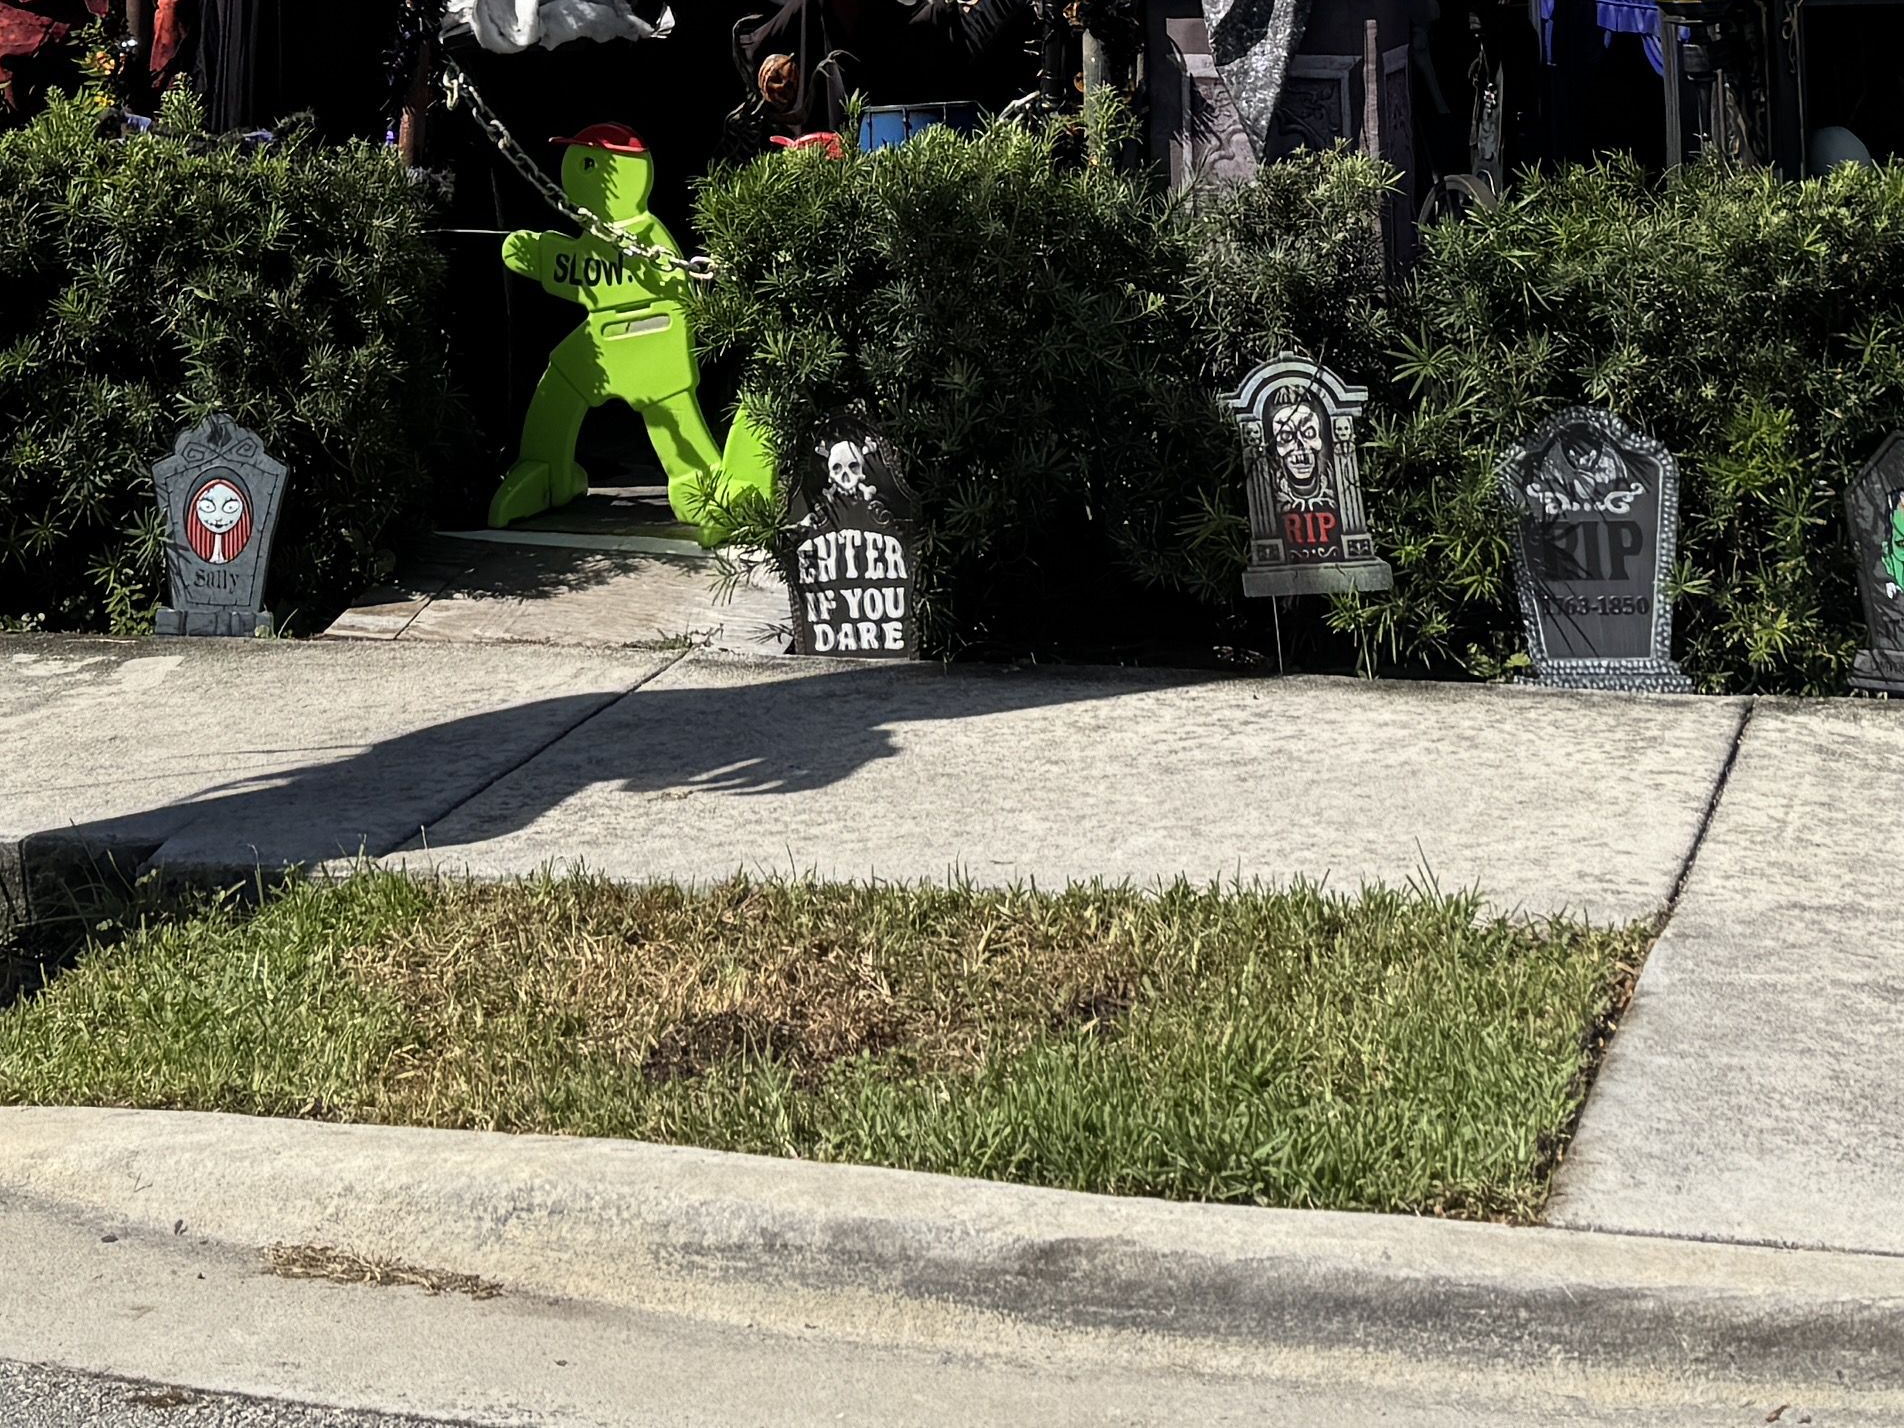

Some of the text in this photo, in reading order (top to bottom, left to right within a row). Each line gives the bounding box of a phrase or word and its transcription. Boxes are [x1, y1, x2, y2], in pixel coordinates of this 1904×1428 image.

[1282, 511, 1337, 544] RIP
[797, 529, 908, 584] ENTER
[1538, 520, 1644, 581] RIP
[194, 569, 239, 594] Sally
[805, 587, 904, 622] IF YOU
[813, 621, 905, 651] DARE
